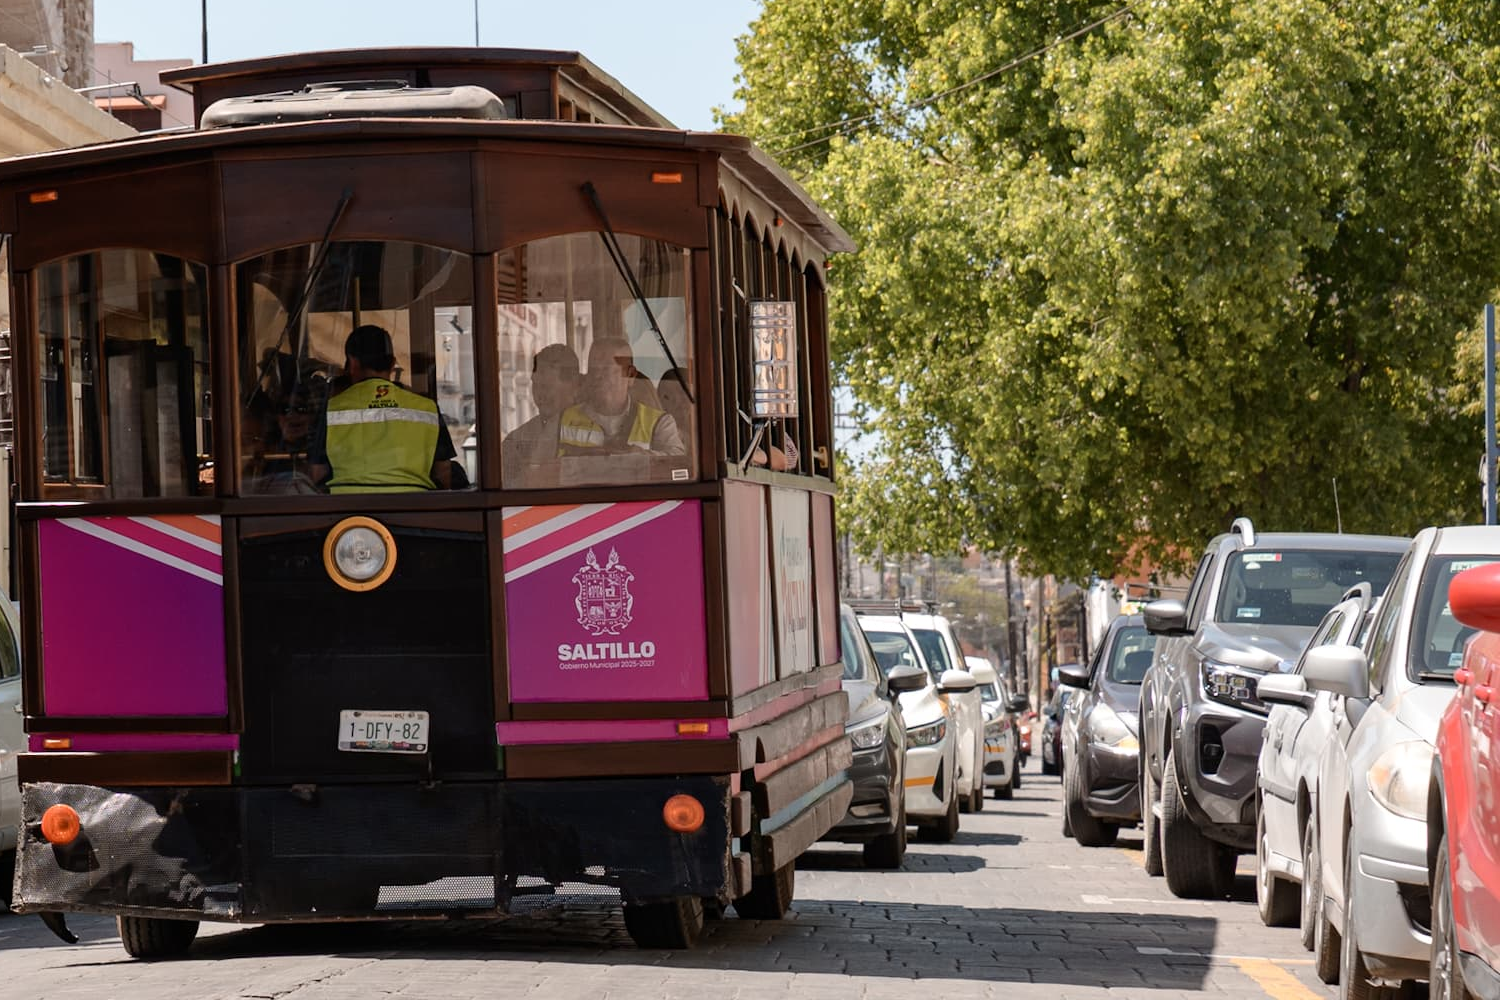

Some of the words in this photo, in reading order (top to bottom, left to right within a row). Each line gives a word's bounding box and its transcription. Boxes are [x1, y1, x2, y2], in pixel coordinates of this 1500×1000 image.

[557, 641, 655, 661] SALTILLO
[559, 662, 589, 670] Gobierno
[590, 661, 620, 670] Municipal
[621, 660, 655, 668] 2025-2027
[350, 722, 421, 740] 1-DFY-82
